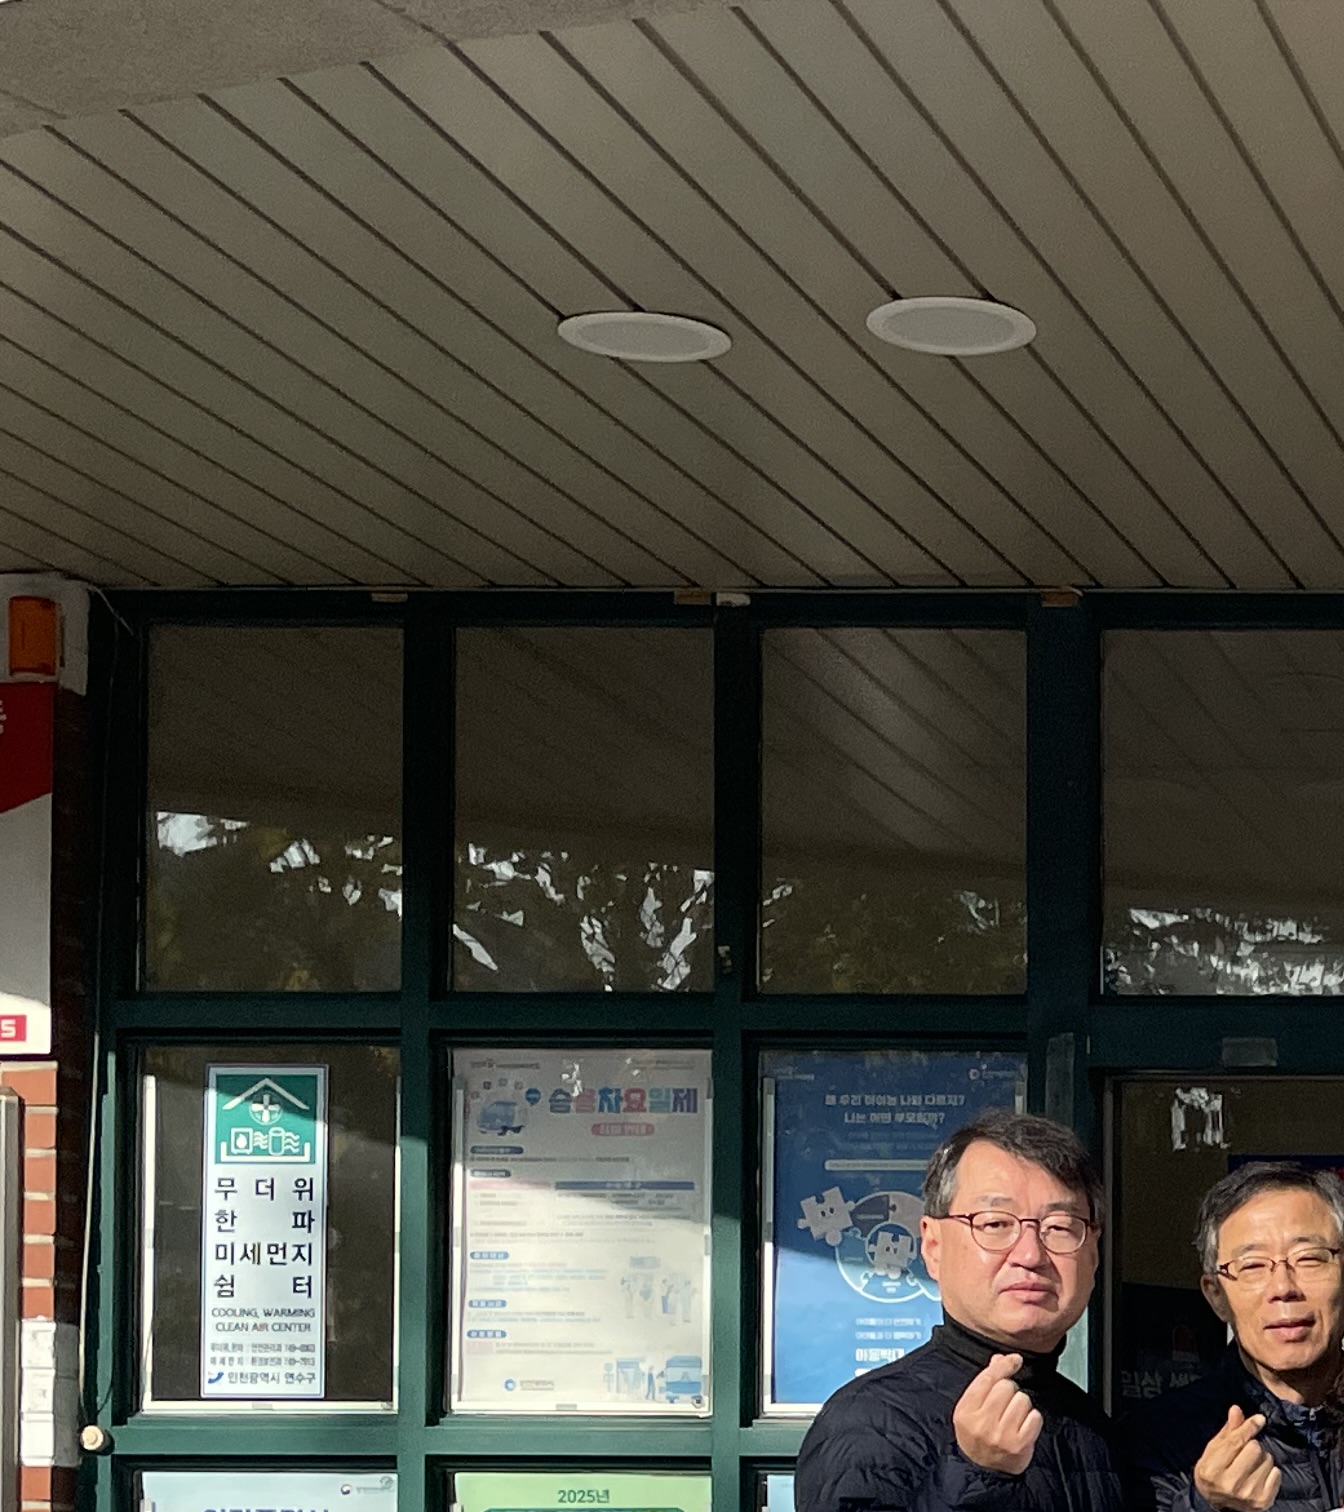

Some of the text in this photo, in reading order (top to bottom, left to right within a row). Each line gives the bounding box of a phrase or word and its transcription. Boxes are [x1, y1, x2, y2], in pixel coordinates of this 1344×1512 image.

[214, 1242, 313, 1266] 미세먼지
[263, 1308, 315, 1318] WARMING
[215, 1322, 312, 1332] CLEAN AIR CENTER
[228, 1371, 316, 1384] 인천광역시 연수구
[557, 1489, 611, 1504] 2025년
